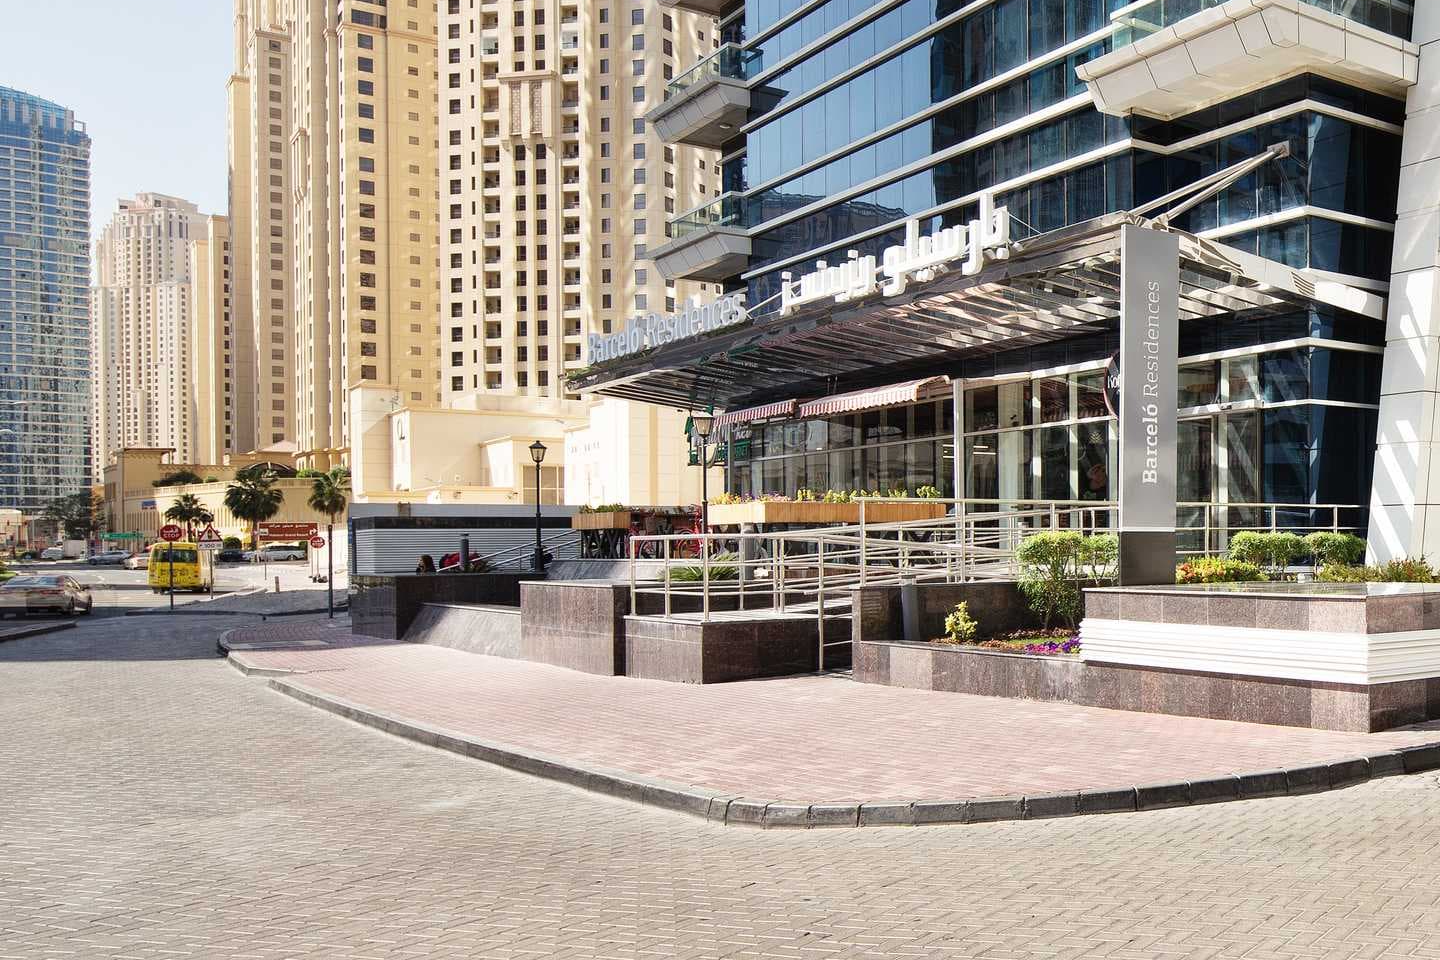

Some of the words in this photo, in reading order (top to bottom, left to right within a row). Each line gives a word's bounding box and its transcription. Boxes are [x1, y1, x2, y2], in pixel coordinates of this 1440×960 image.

[646, 294, 746, 349] Residences
[1143, 281, 1160, 398] Residences
[1142, 404, 1158, 484] Barceló
